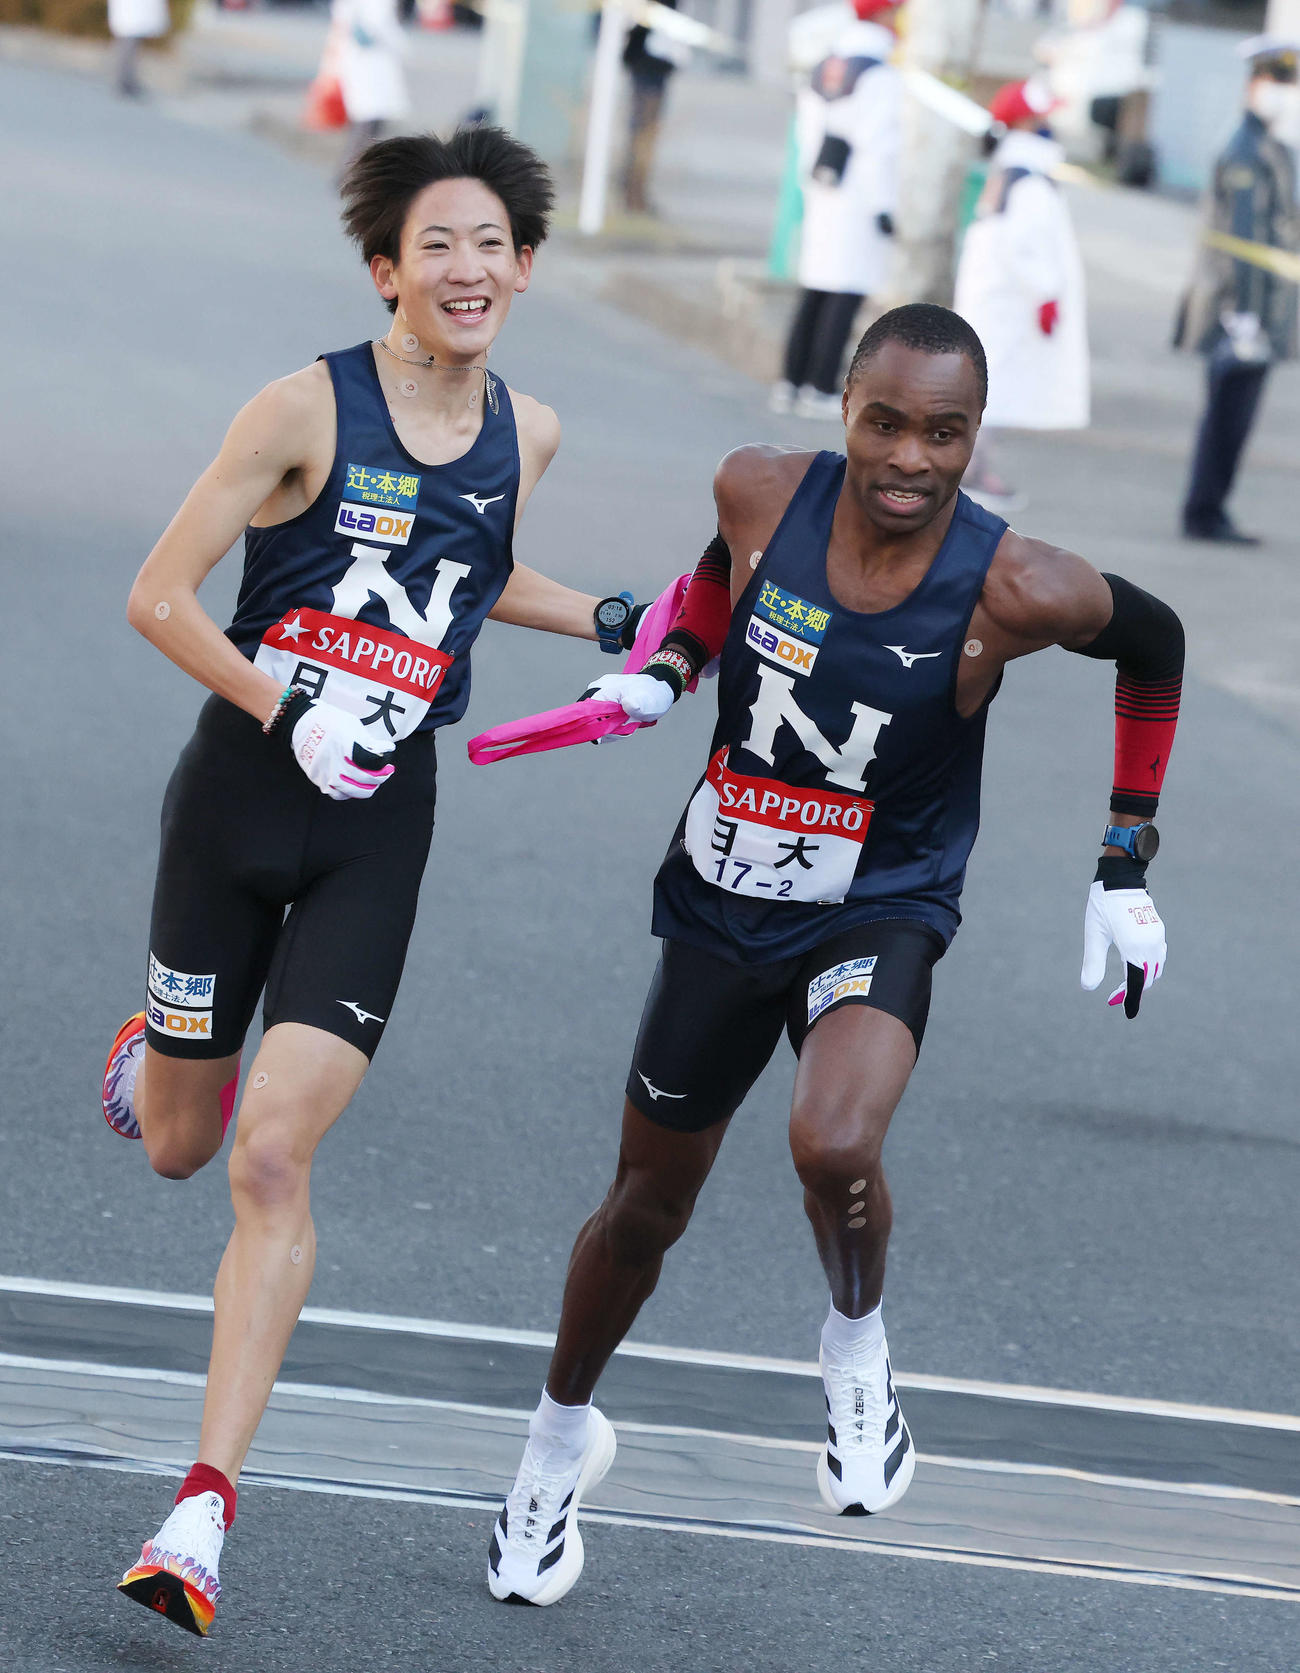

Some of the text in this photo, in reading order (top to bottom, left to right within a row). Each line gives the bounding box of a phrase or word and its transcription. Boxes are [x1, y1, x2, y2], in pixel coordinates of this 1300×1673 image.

[361, 491, 400, 505] 税理士法人
[769, 611, 804, 635] 税理士法人
[312, 627, 441, 690] SAPPORO
[741, 662, 893, 792] N
[720, 782, 864, 831] SAPPORO
